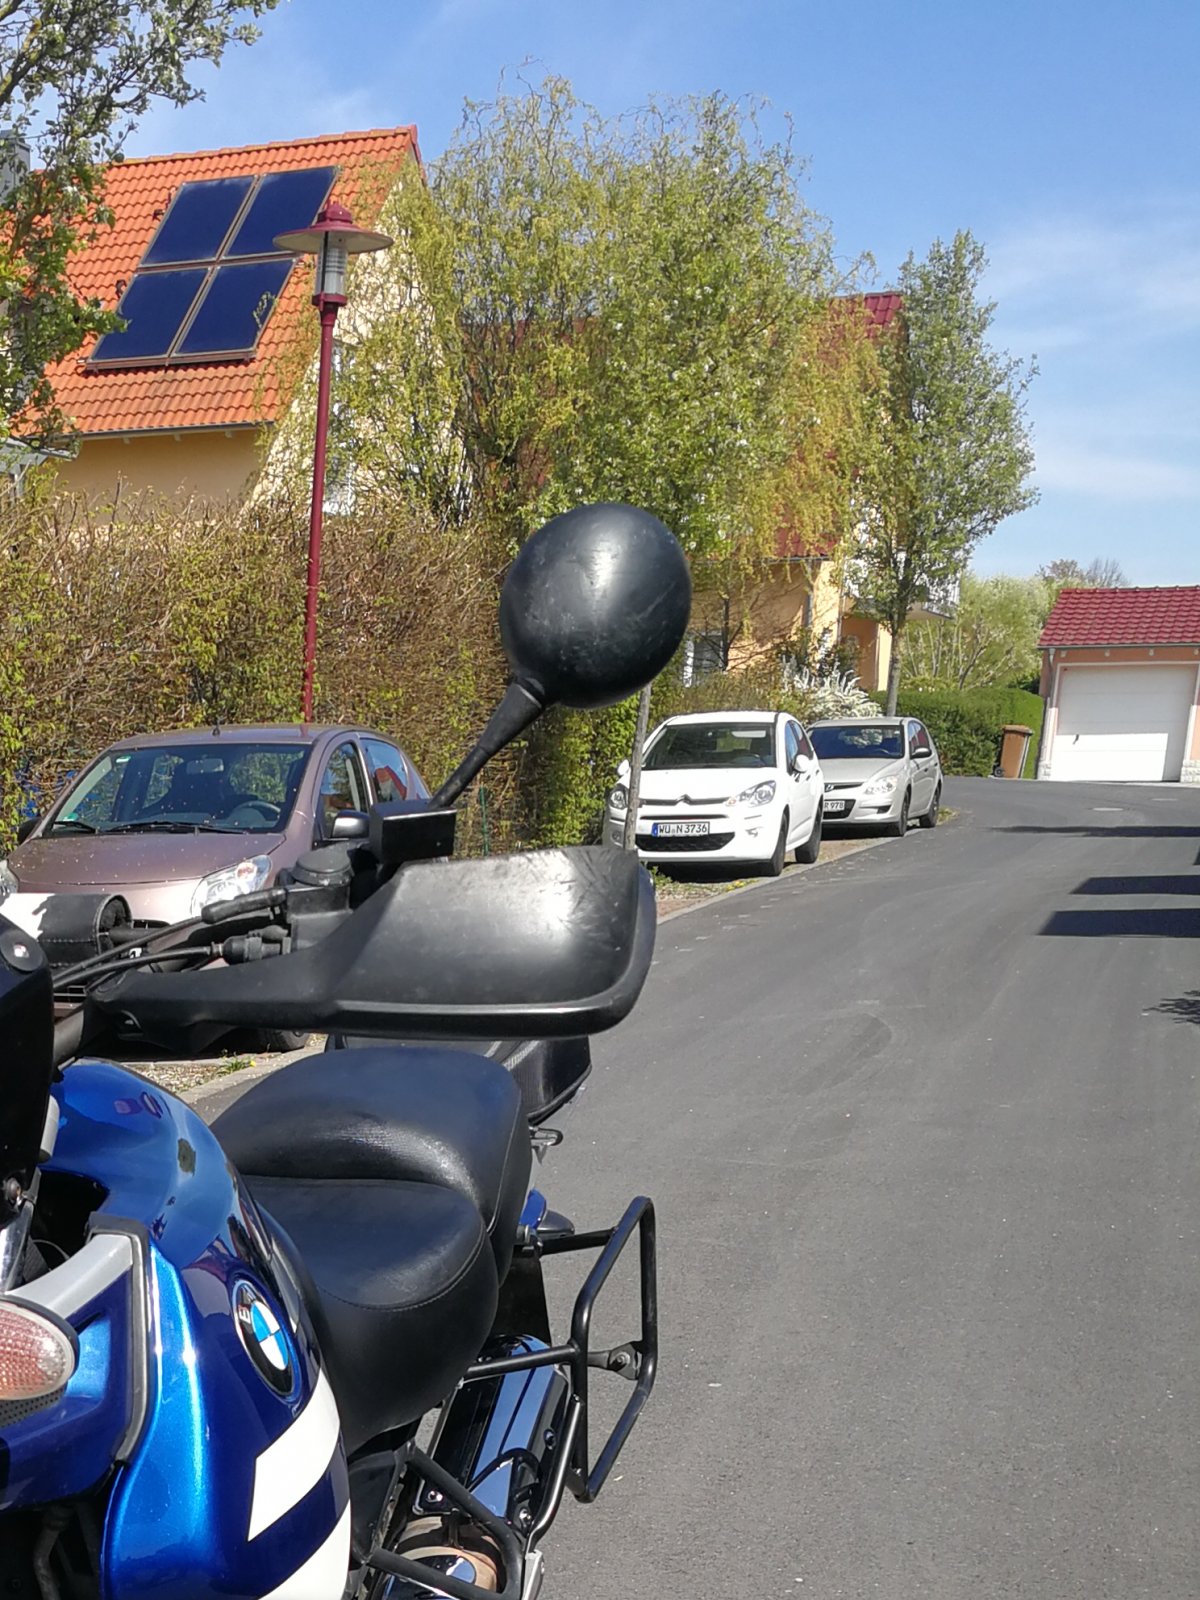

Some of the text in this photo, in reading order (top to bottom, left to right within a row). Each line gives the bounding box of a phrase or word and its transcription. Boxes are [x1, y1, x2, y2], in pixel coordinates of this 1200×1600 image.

[659, 823, 708, 834] WU N 3736
